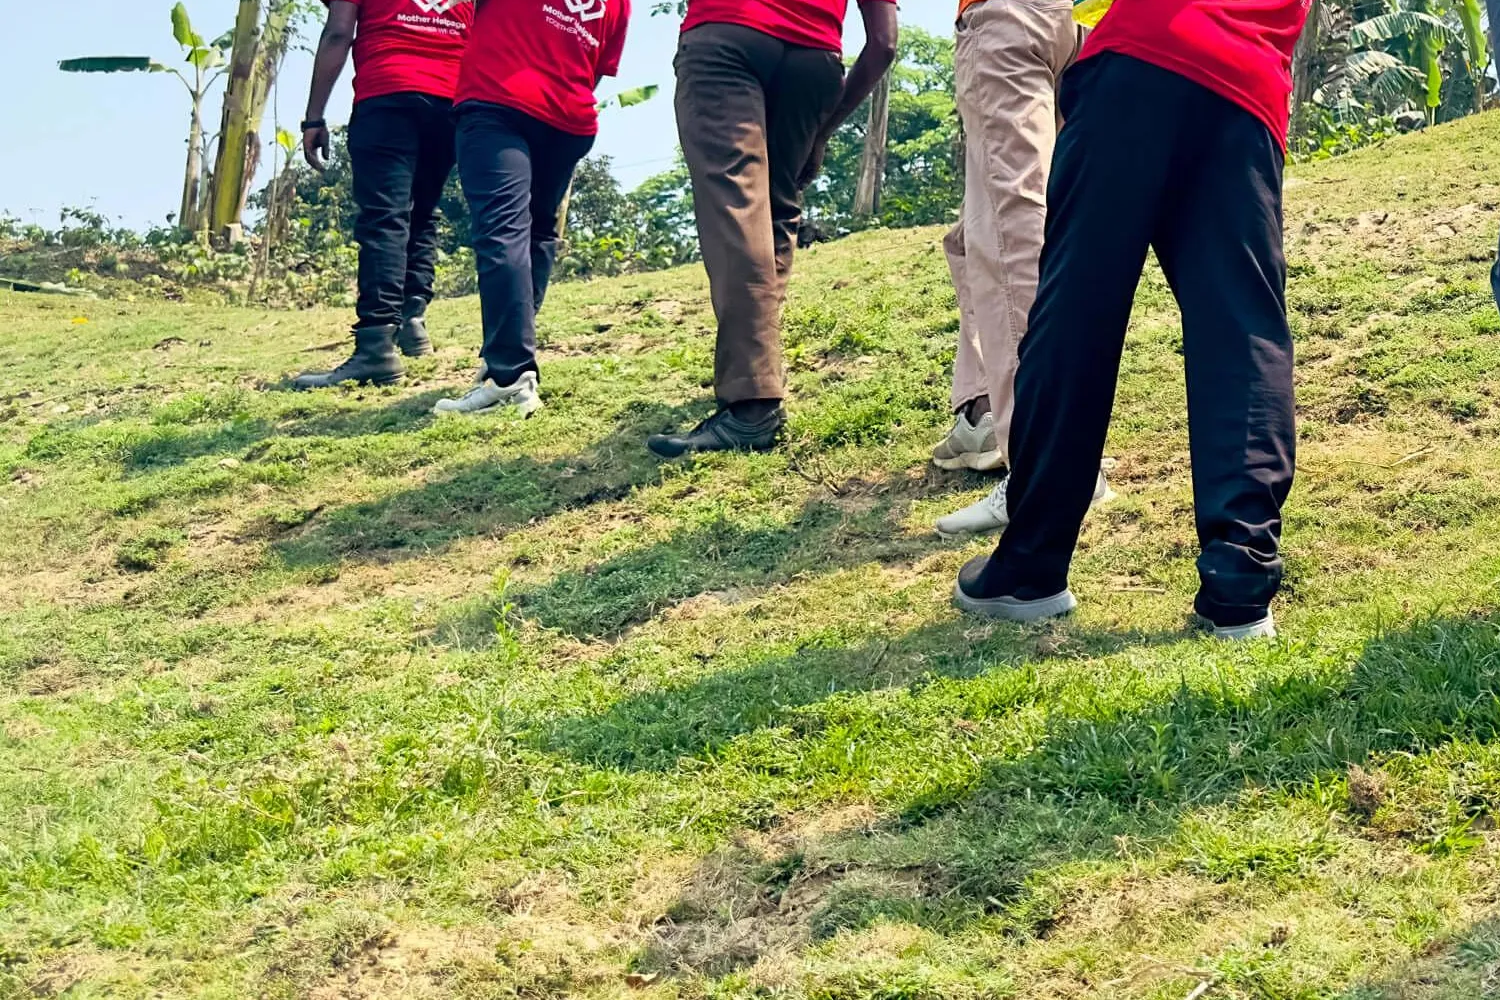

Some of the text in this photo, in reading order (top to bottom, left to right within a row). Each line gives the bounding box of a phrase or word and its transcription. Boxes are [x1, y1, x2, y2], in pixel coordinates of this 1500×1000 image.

[397, 13, 431, 24] Mother
[432, 16, 467, 30] Helpage
[543, 4, 576, 23] Mother
